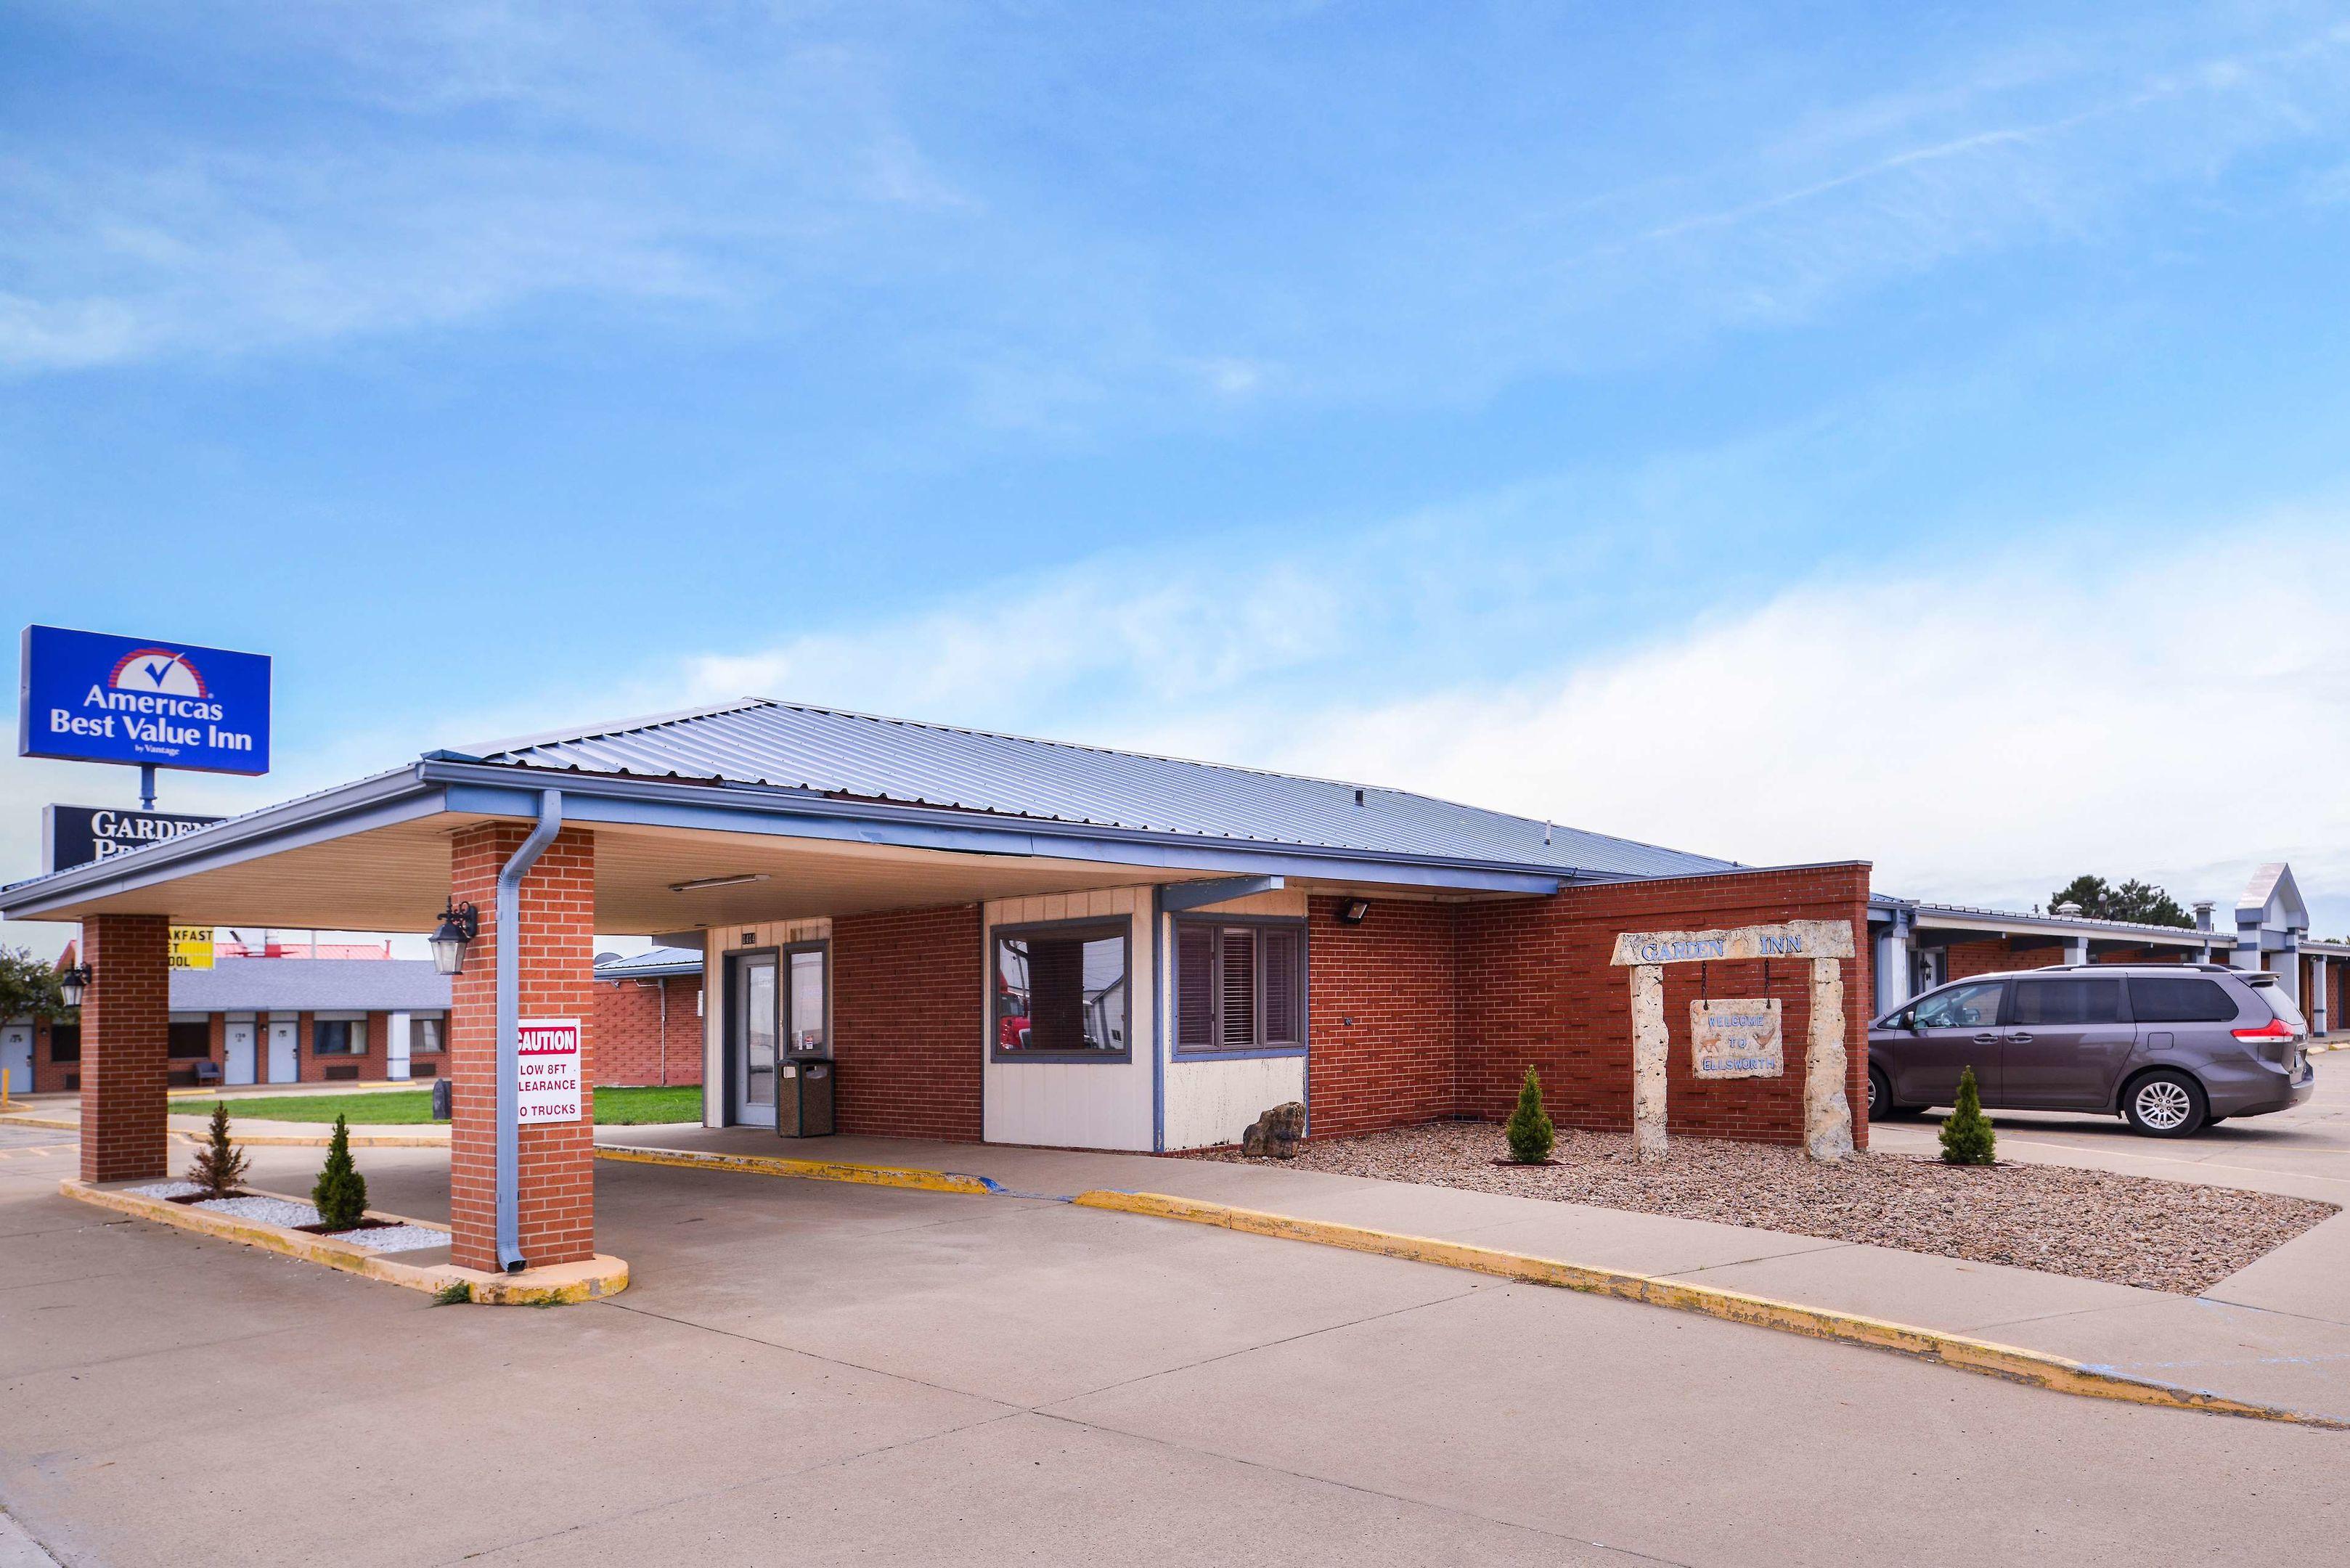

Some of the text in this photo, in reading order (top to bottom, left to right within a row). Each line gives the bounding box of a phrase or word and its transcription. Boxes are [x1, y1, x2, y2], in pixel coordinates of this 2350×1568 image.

[83, 685, 223, 721] Americas
[51, 709, 252, 751] Best Value Inn
[134, 744, 180, 756] by Vantage
[1641, 934, 1802, 962] GARDEN INN
[1708, 1016, 1764, 1027] WELCOME
[1729, 1037, 1747, 1048] TO
[521, 1064, 566, 1075] LOW 8FT
[1703, 1058, 1776, 1071] ELLSWORTH
[518, 1079, 576, 1092] LEARANCE
[531, 1104, 576, 1116] TRUCKS
